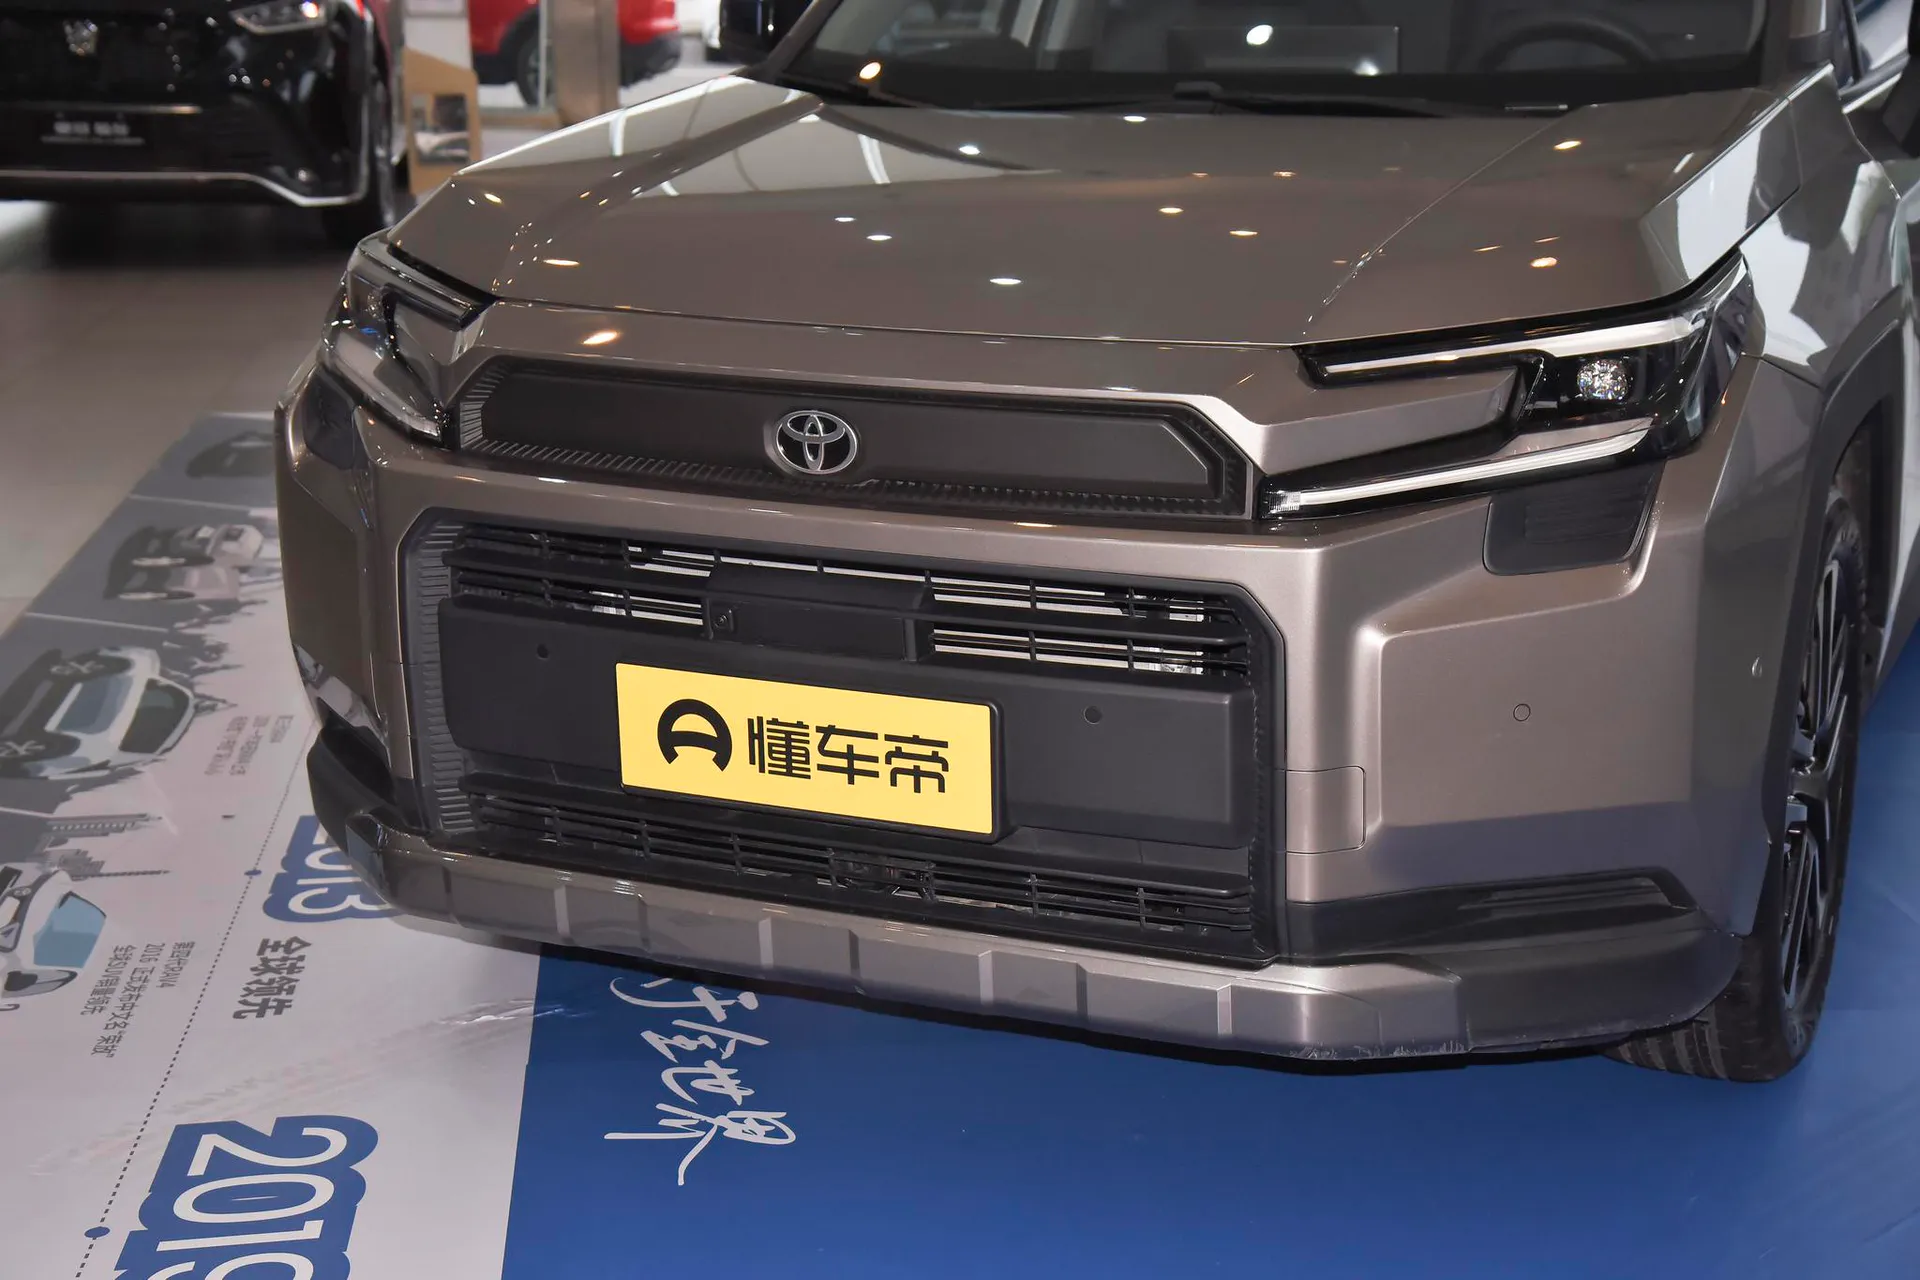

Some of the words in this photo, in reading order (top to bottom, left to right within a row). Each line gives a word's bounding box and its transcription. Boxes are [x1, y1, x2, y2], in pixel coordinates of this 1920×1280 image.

[747, 716, 949, 793] 懂车帝
[156, 942, 195, 988] 第四代RAV4
[232, 936, 312, 1019] 全球领先
[146, 1127, 347, 1280] 2019
